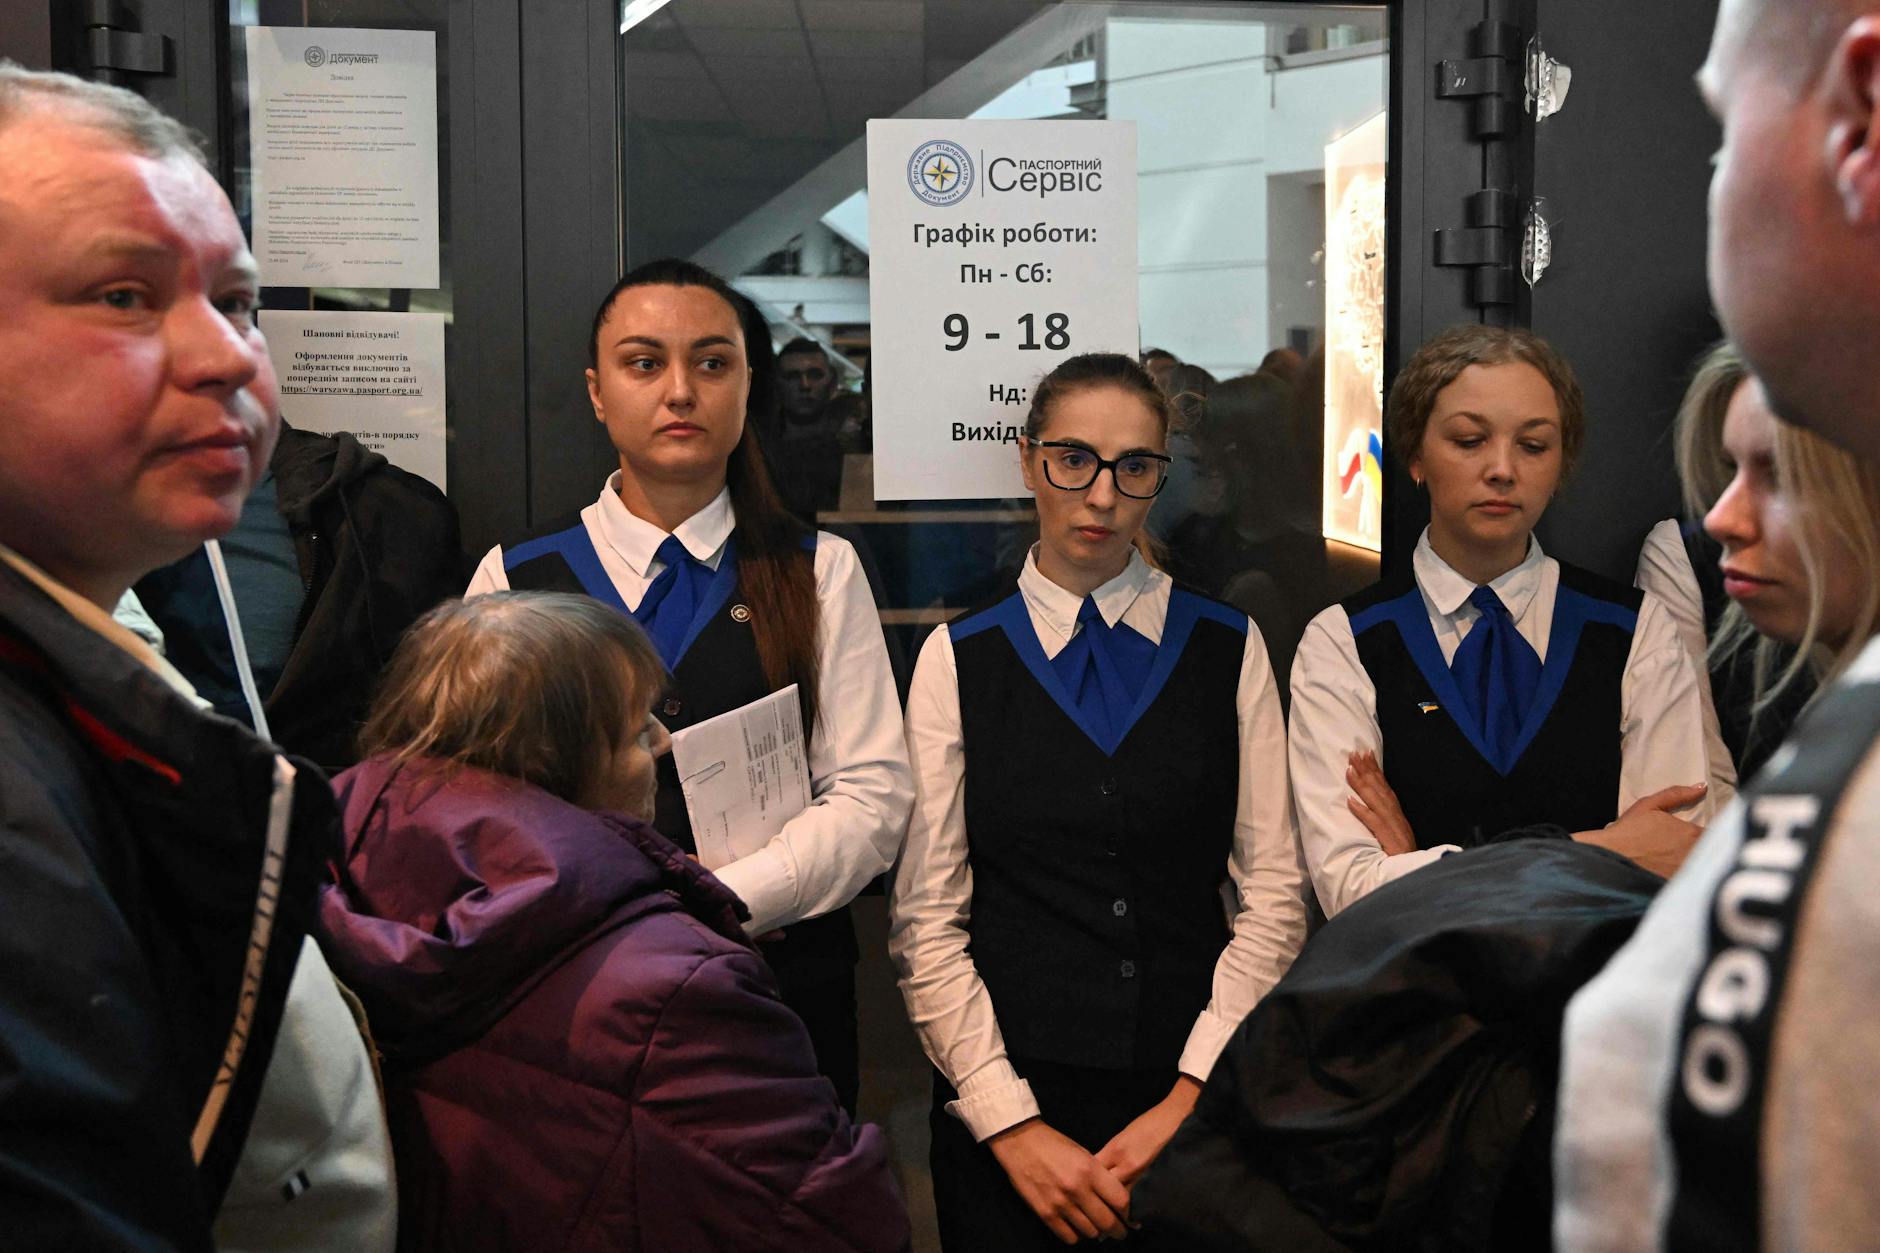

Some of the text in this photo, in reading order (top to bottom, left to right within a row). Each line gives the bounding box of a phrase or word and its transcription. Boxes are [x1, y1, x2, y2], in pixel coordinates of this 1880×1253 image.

[329, 53, 379, 65] Документ
[913, 148, 931, 186] Державне
[1019, 158, 1102, 170] ПАСПОРТНИЙ
[988, 157, 1102, 198] Сервіс
[921, 190, 960, 202] Документ
[913, 222, 1097, 248] Графік роботи:
[960, 264, 992, 283] Пн
[1015, 263, 1052, 283] Сб:
[303, 329, 400, 340] Шановні відвідувачі!
[943, 313, 969, 351] 9
[1017, 312, 1071, 350] 18
[295, 351, 408, 363] Оформлення документів
[292, 363, 350, 373] відбувається
[287, 374, 338, 383] попереднім
[393, 375, 417, 383] сайті
[281, 385, 423, 395] https://warszawa.pasport.org.ua/
[989, 384, 1027, 405] Нд:
[382, 432, 420, 441] порядку
[1681, 793, 1821, 1118] HUGO
